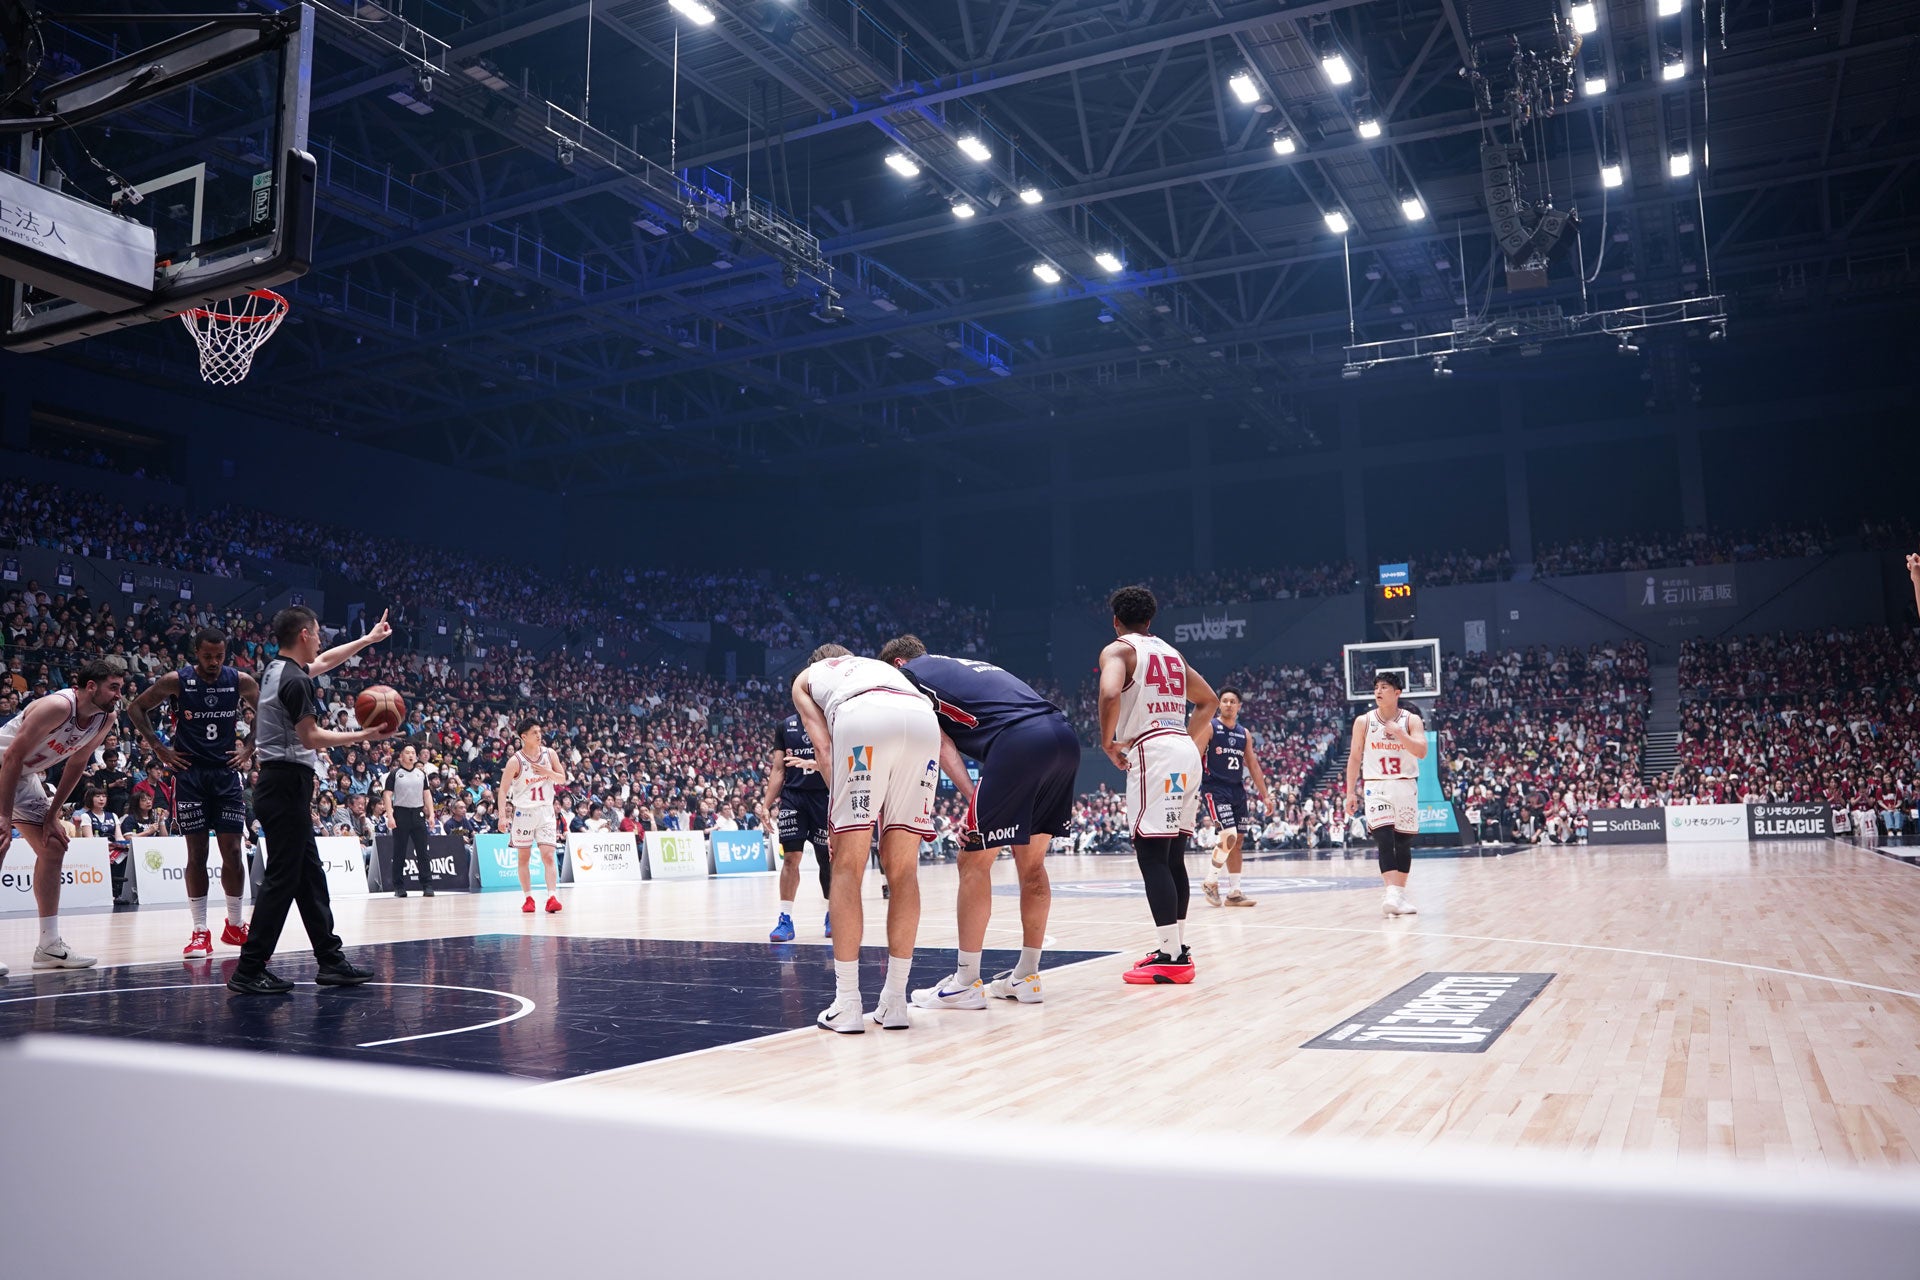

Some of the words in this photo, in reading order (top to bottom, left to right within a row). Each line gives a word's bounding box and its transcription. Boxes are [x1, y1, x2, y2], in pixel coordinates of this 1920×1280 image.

[1384, 585, 1411, 599] 6:47
[1662, 584, 1733, 604] 石川酒販
[1144, 652, 1185, 698] 45
[206, 723, 218, 740] 8
[794, 747, 815, 756] SYNC
[1227, 757, 1240, 770] 23
[1379, 757, 1401, 774] 13
[530, 787, 545, 801] 11
[1766, 806, 1824, 815] りそなグループ
[1609, 819, 1661, 831] SoftBank
[1684, 817, 1741, 826] りそなグループ
[1754, 819, 1826, 835] B.LEAGUE
[593, 843, 631, 853] SYNCRON
[731, 842, 760, 860] センダ
[493, 847, 542, 867] WES
[603, 853, 623, 861] KOWA
[392, 855, 458, 876] PAING
